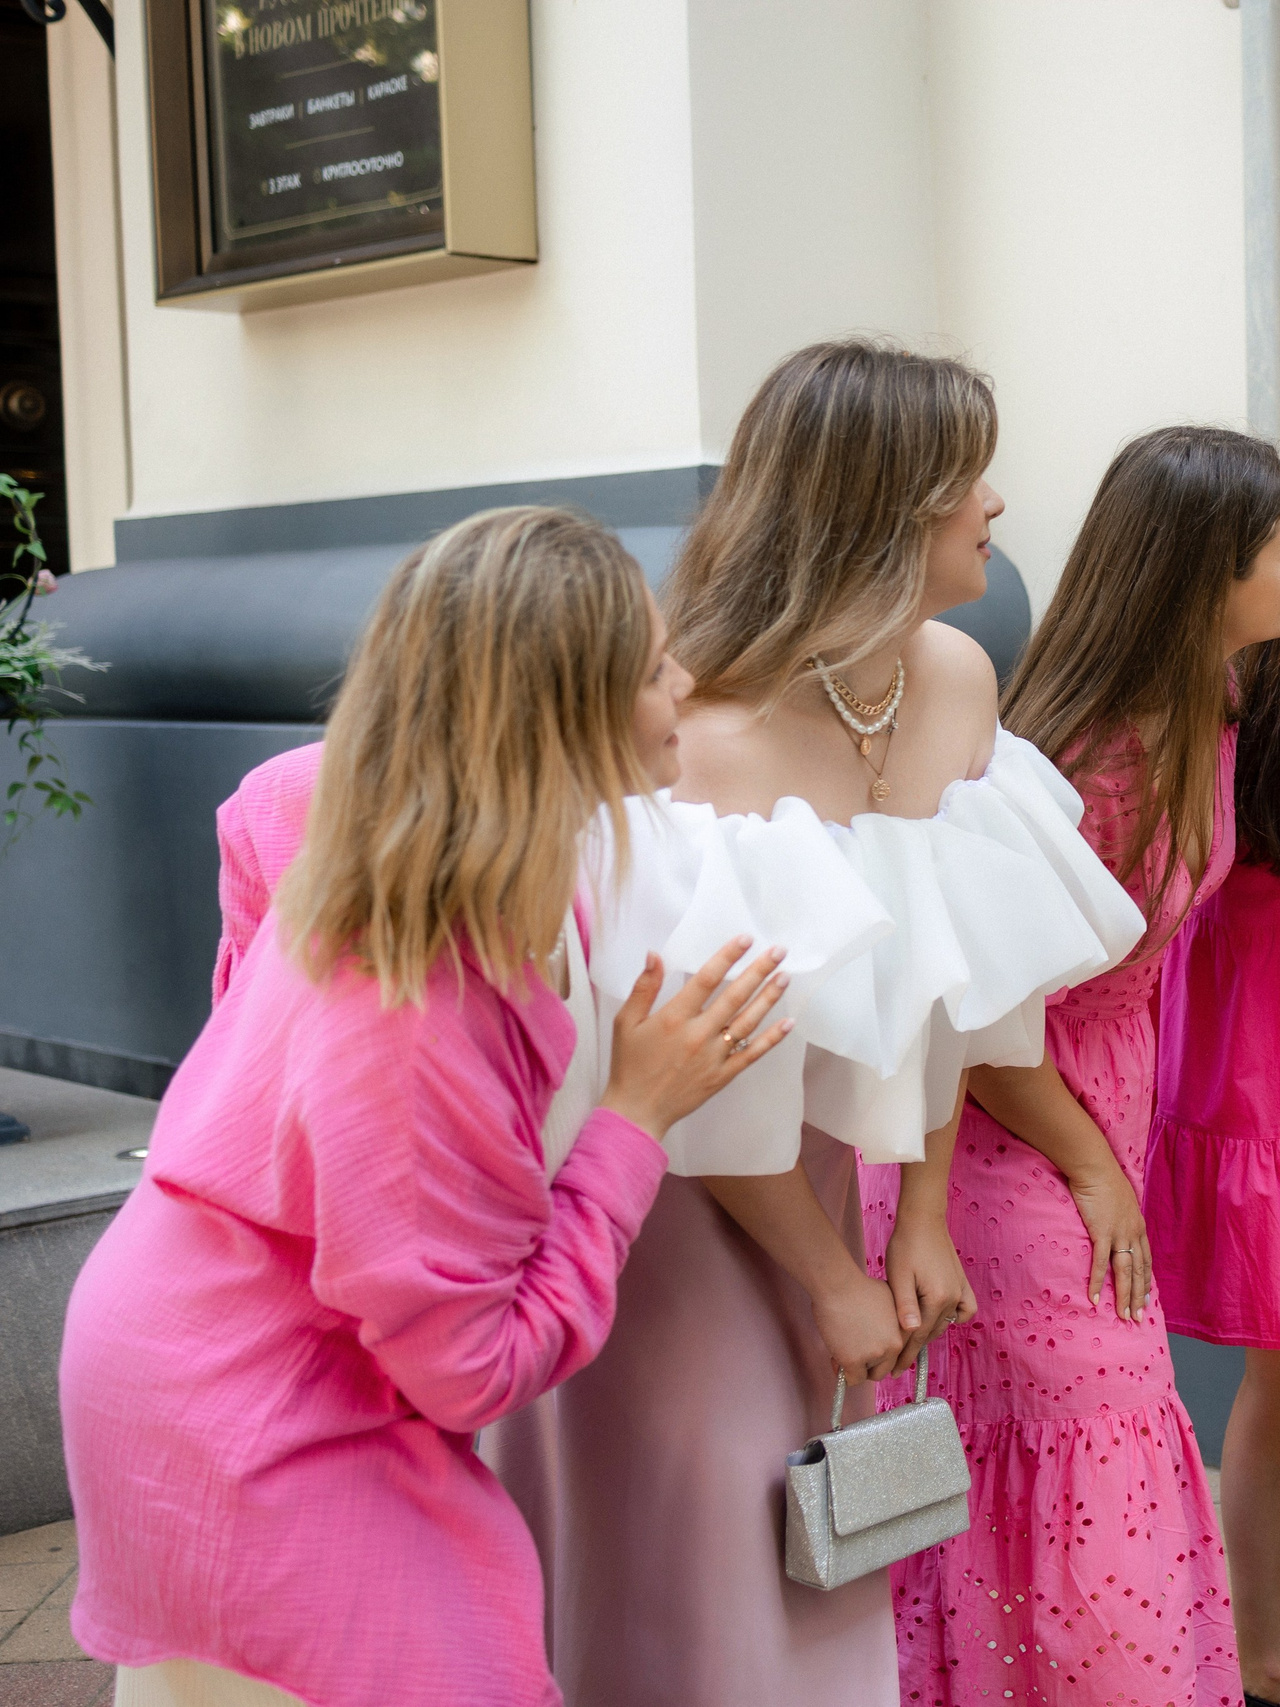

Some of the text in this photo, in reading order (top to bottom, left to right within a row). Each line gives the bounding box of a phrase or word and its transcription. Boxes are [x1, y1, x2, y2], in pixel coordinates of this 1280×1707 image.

[248, 13, 312, 57] НОВОМ
[249, 74, 408, 130] ЗАВТРАКИ БАНКЕТЫ КАРАОКЕ
[276, 172, 301, 193] ЭТАЖ
[322, 151, 404, 182] КРУГЛОСУТОЧНО
